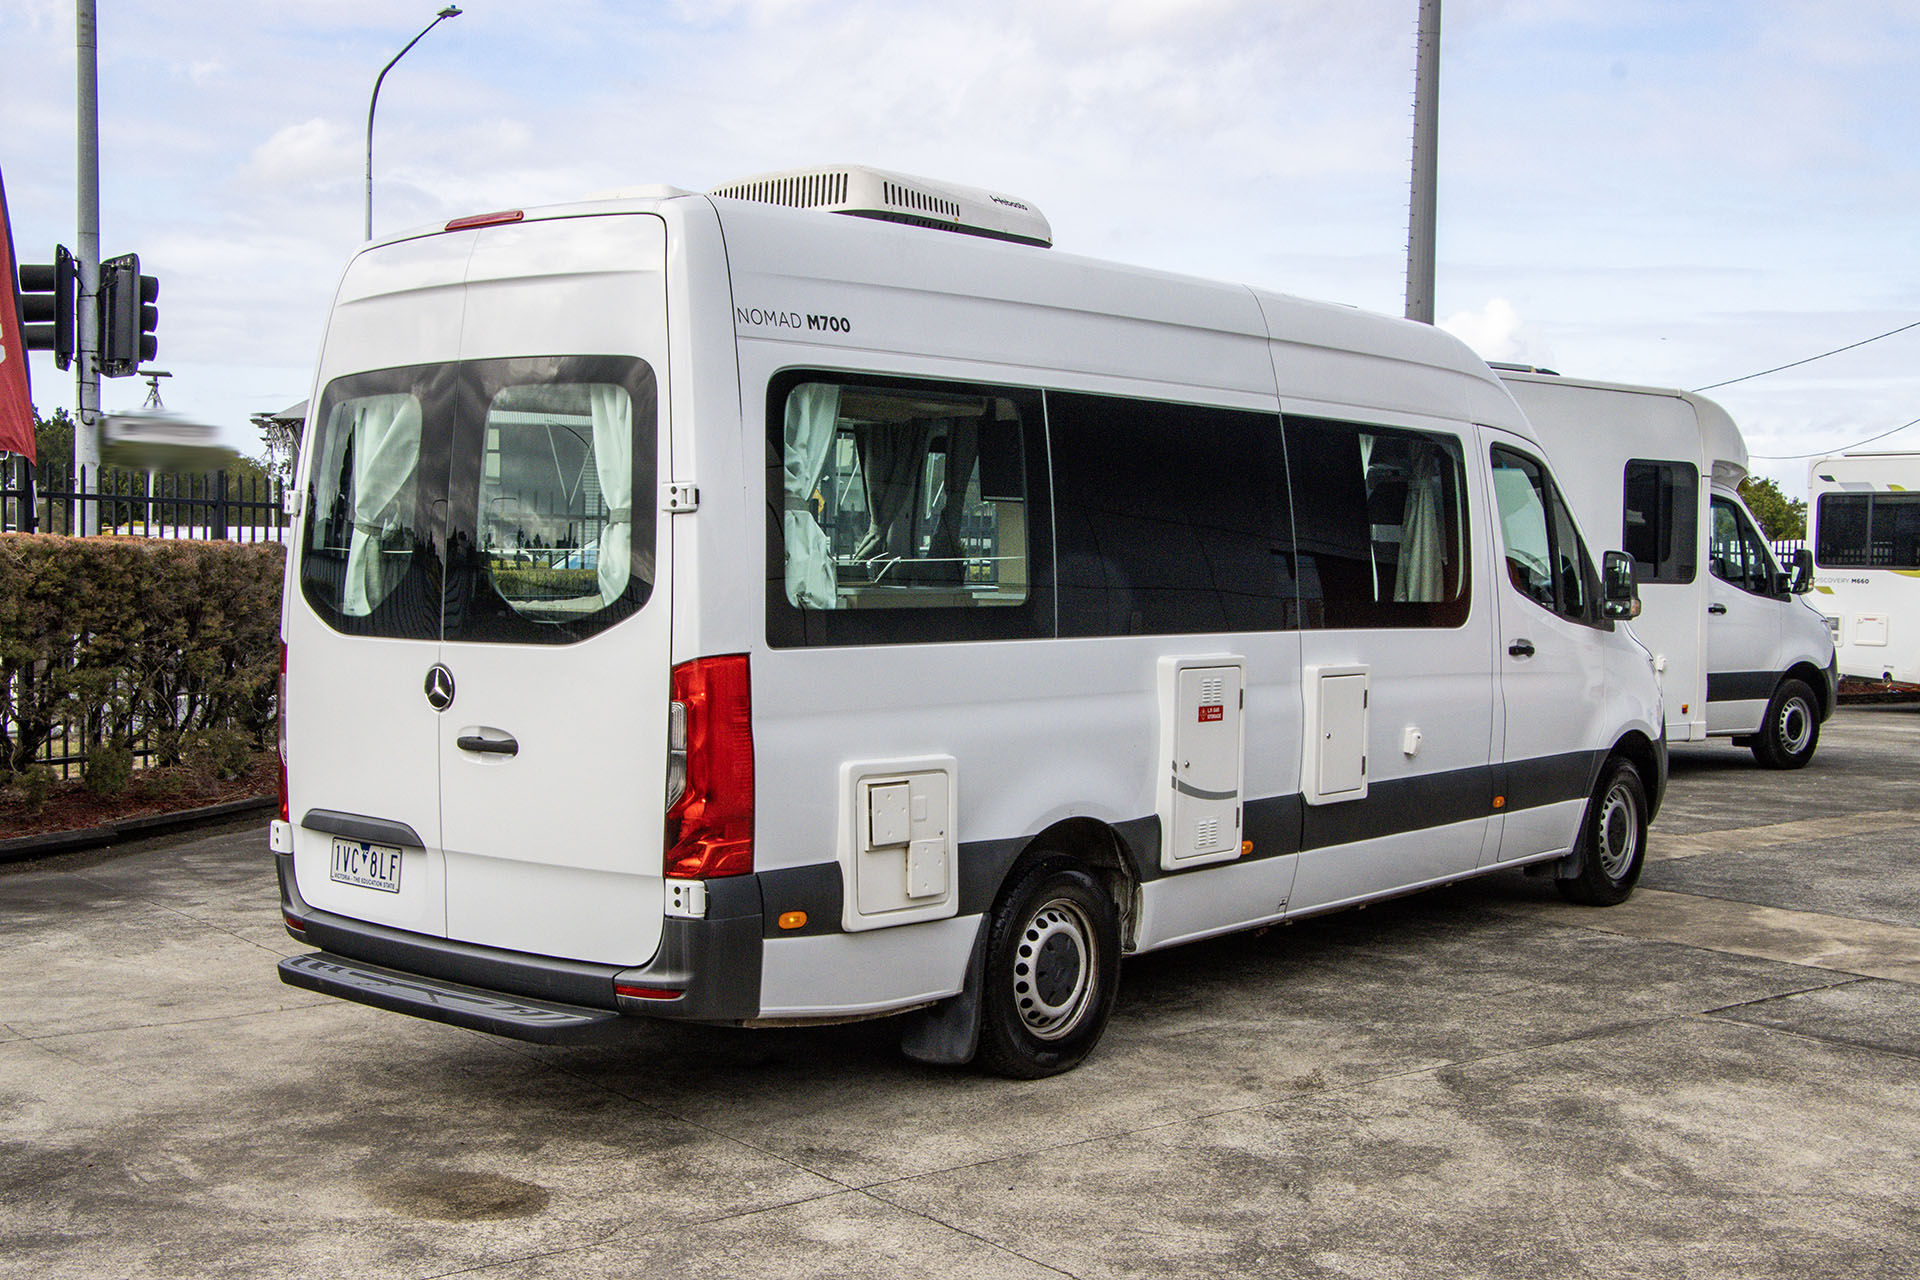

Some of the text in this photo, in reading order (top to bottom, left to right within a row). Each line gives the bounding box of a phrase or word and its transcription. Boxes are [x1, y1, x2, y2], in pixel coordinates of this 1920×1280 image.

[737, 307, 851, 333] NOMAD M700
[370, 851, 398, 881] 8LF
